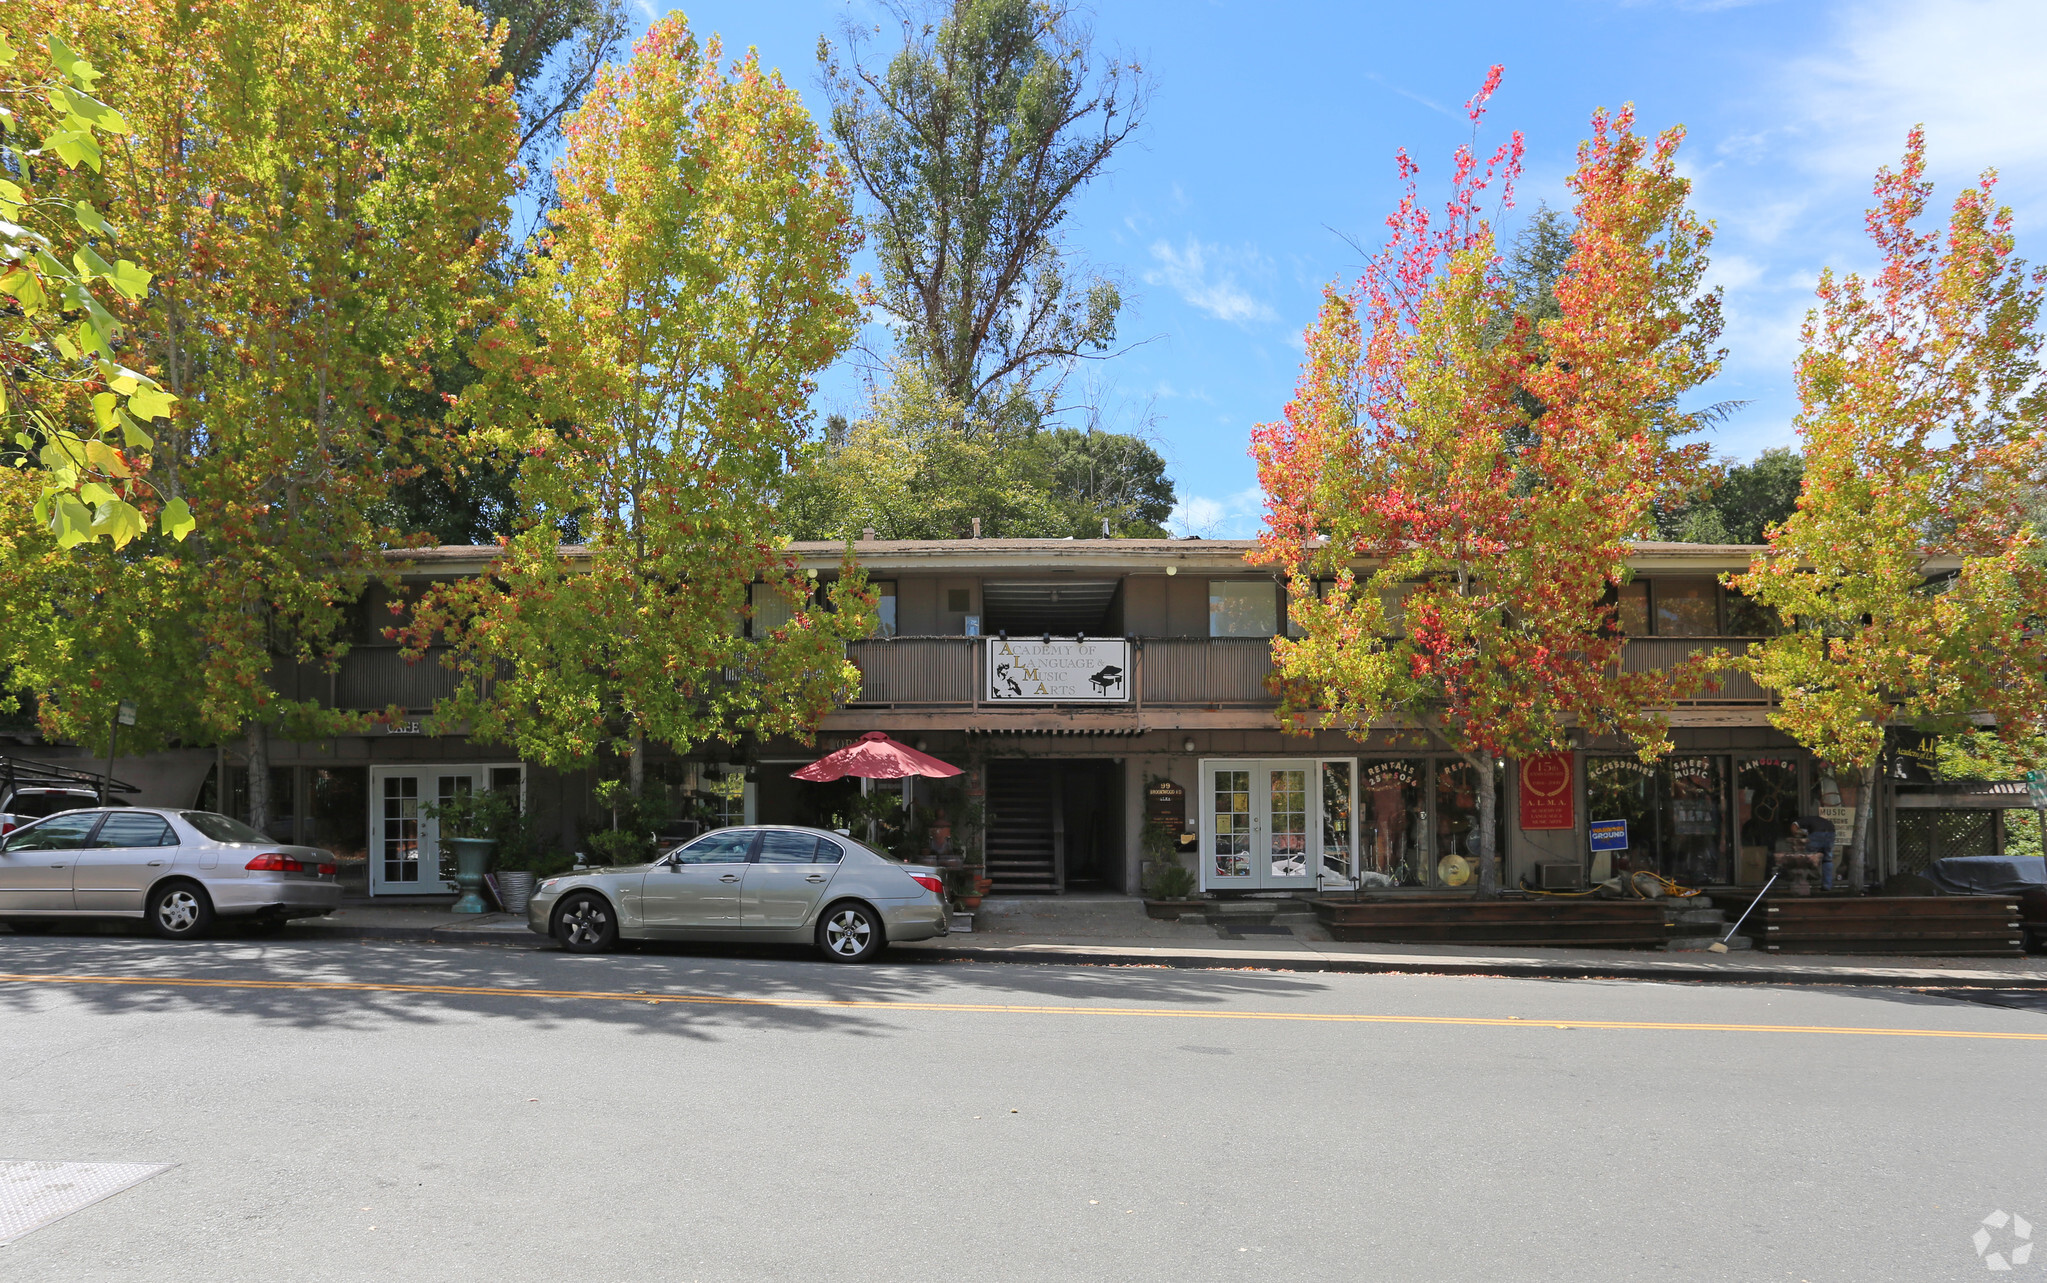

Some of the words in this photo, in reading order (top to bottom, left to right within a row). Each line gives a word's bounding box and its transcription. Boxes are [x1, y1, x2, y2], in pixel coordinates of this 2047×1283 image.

[999, 643, 1073, 656] ACADEMY
[1079, 645, 1097, 655] OF
[1014, 656, 1095, 669] LANGUAGE
[1097, 659, 1105, 667] &
[1022, 668, 1068, 682] MUSIC
[1034, 682, 1076, 696] ARTS
[1368, 761, 1415, 776] RENTALS
[1444, 762, 1472, 775] REPA
[1537, 761, 1559, 772] 15th
[1590, 760, 1655, 779] ACCESSORIES
[1674, 759, 1710, 770] SHEET
[1739, 758, 1795, 773] LANGUAGE
[1674, 768, 1709, 779] MUSIC
[1819, 808, 1846, 816] MUSIC
[1592, 831, 1625, 839] GROUND
